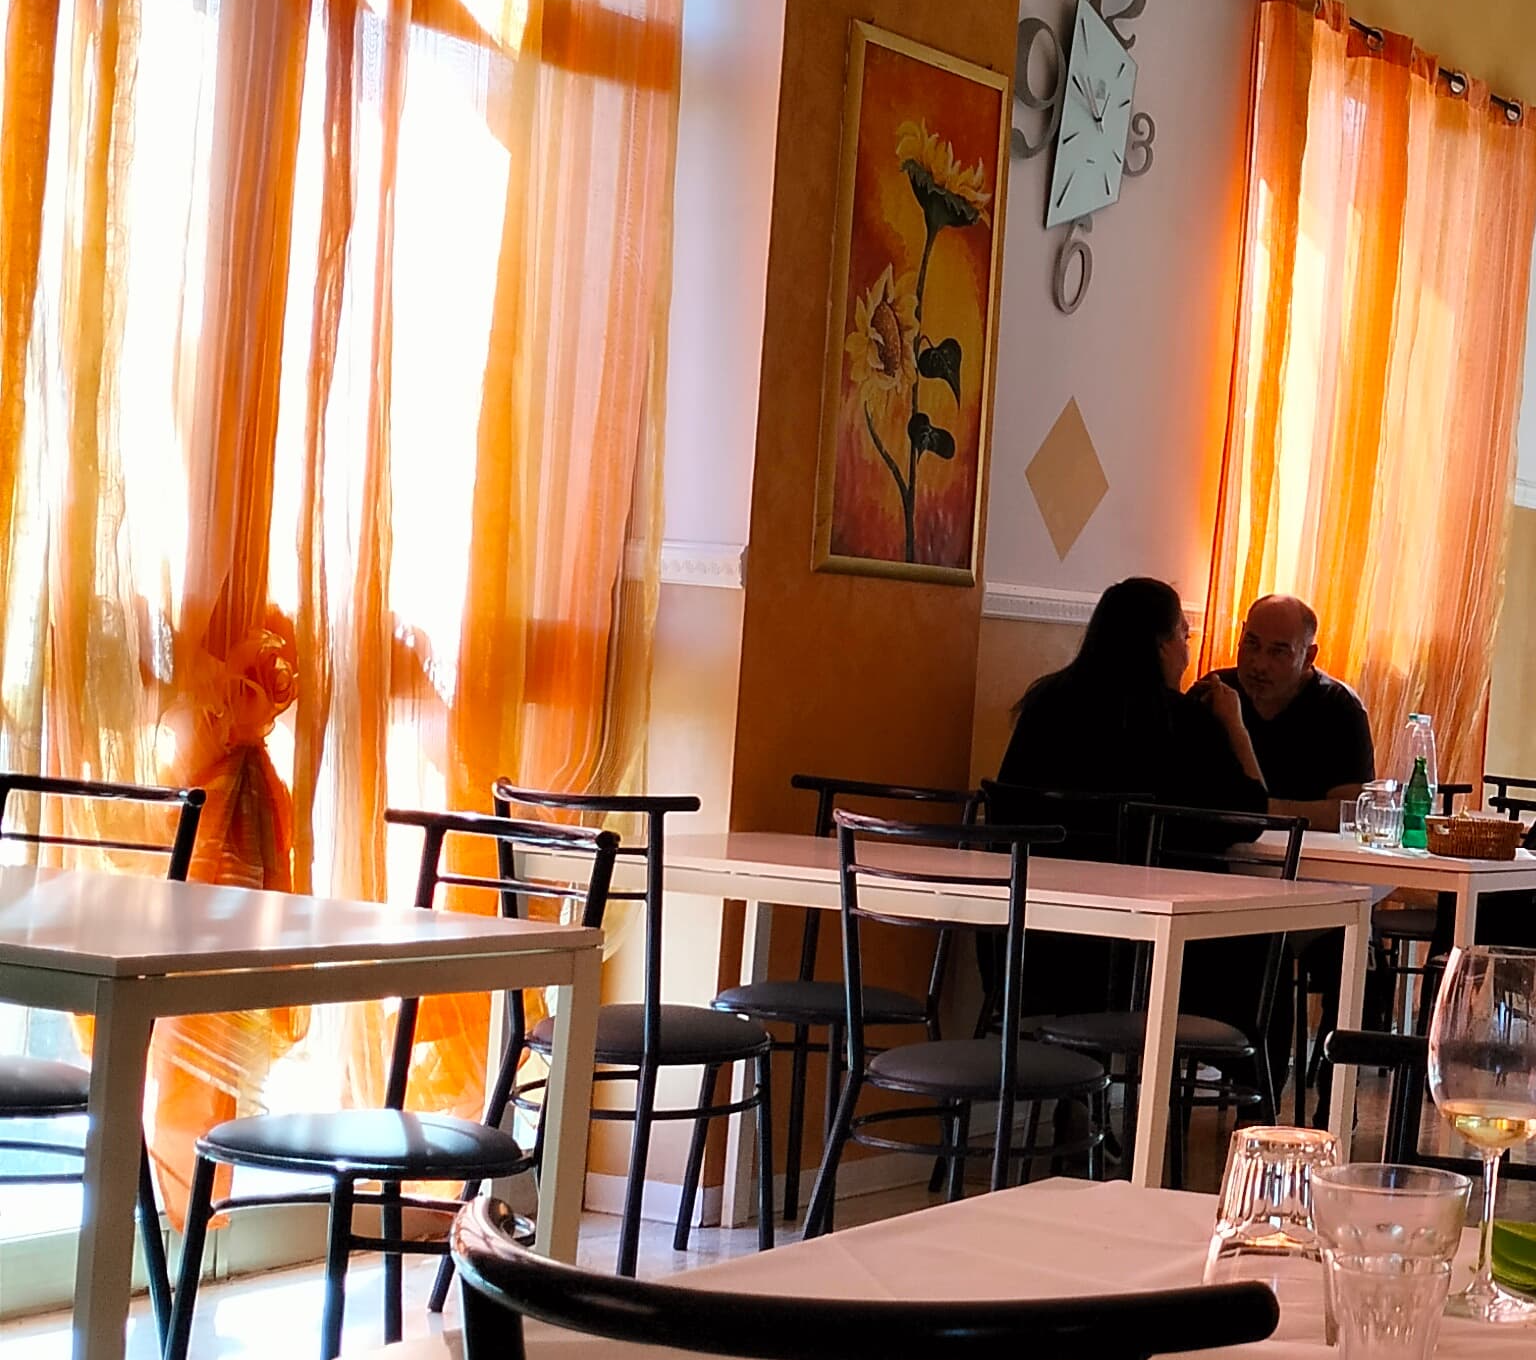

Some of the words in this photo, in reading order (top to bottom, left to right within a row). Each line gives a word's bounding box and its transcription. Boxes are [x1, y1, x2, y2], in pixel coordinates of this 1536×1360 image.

[1010, 16, 1067, 159] 9
[1122, 111, 1155, 177] 3
[1052, 216, 1093, 315] 6
